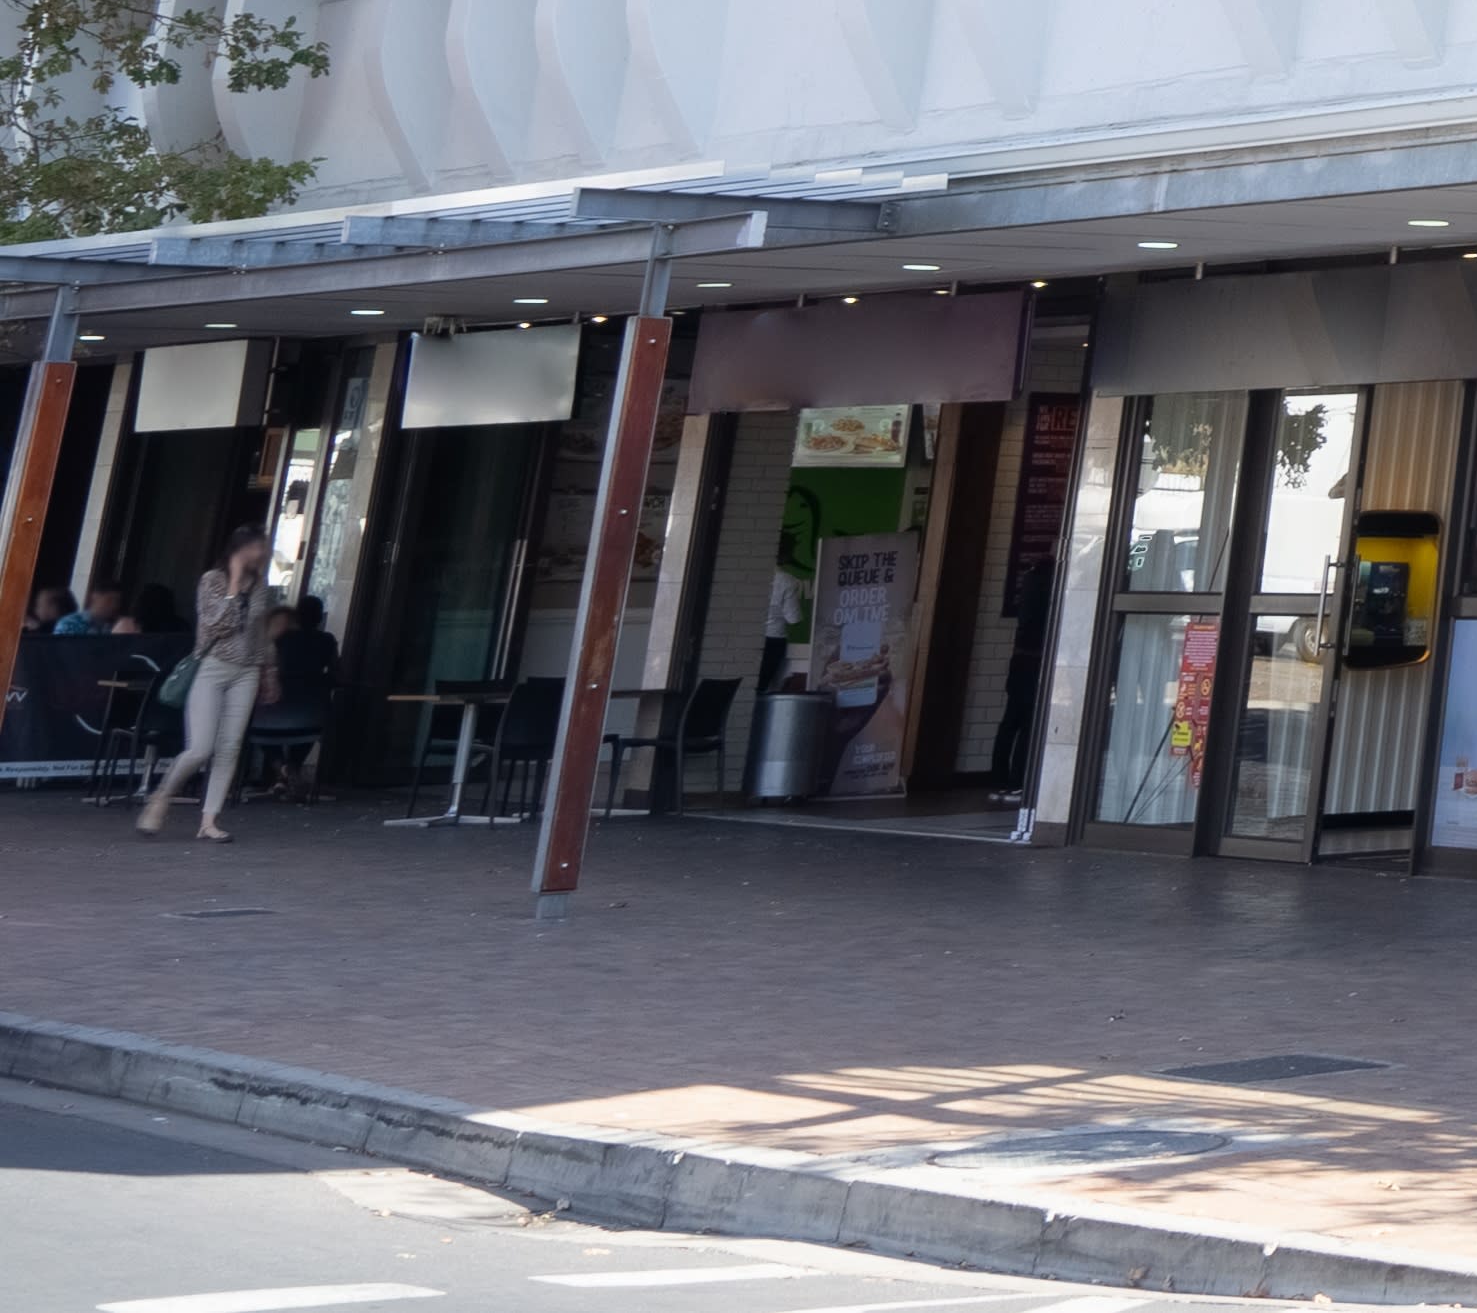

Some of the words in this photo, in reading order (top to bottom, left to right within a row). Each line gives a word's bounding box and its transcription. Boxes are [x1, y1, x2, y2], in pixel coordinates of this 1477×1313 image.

[838, 554, 870, 570] SKIP
[874, 551, 898, 566] THE
[838, 568, 880, 587] QUEUE
[883, 568, 894, 583] &
[841, 586, 887, 607] ORDER
[833, 606, 888, 625] ONLINE
